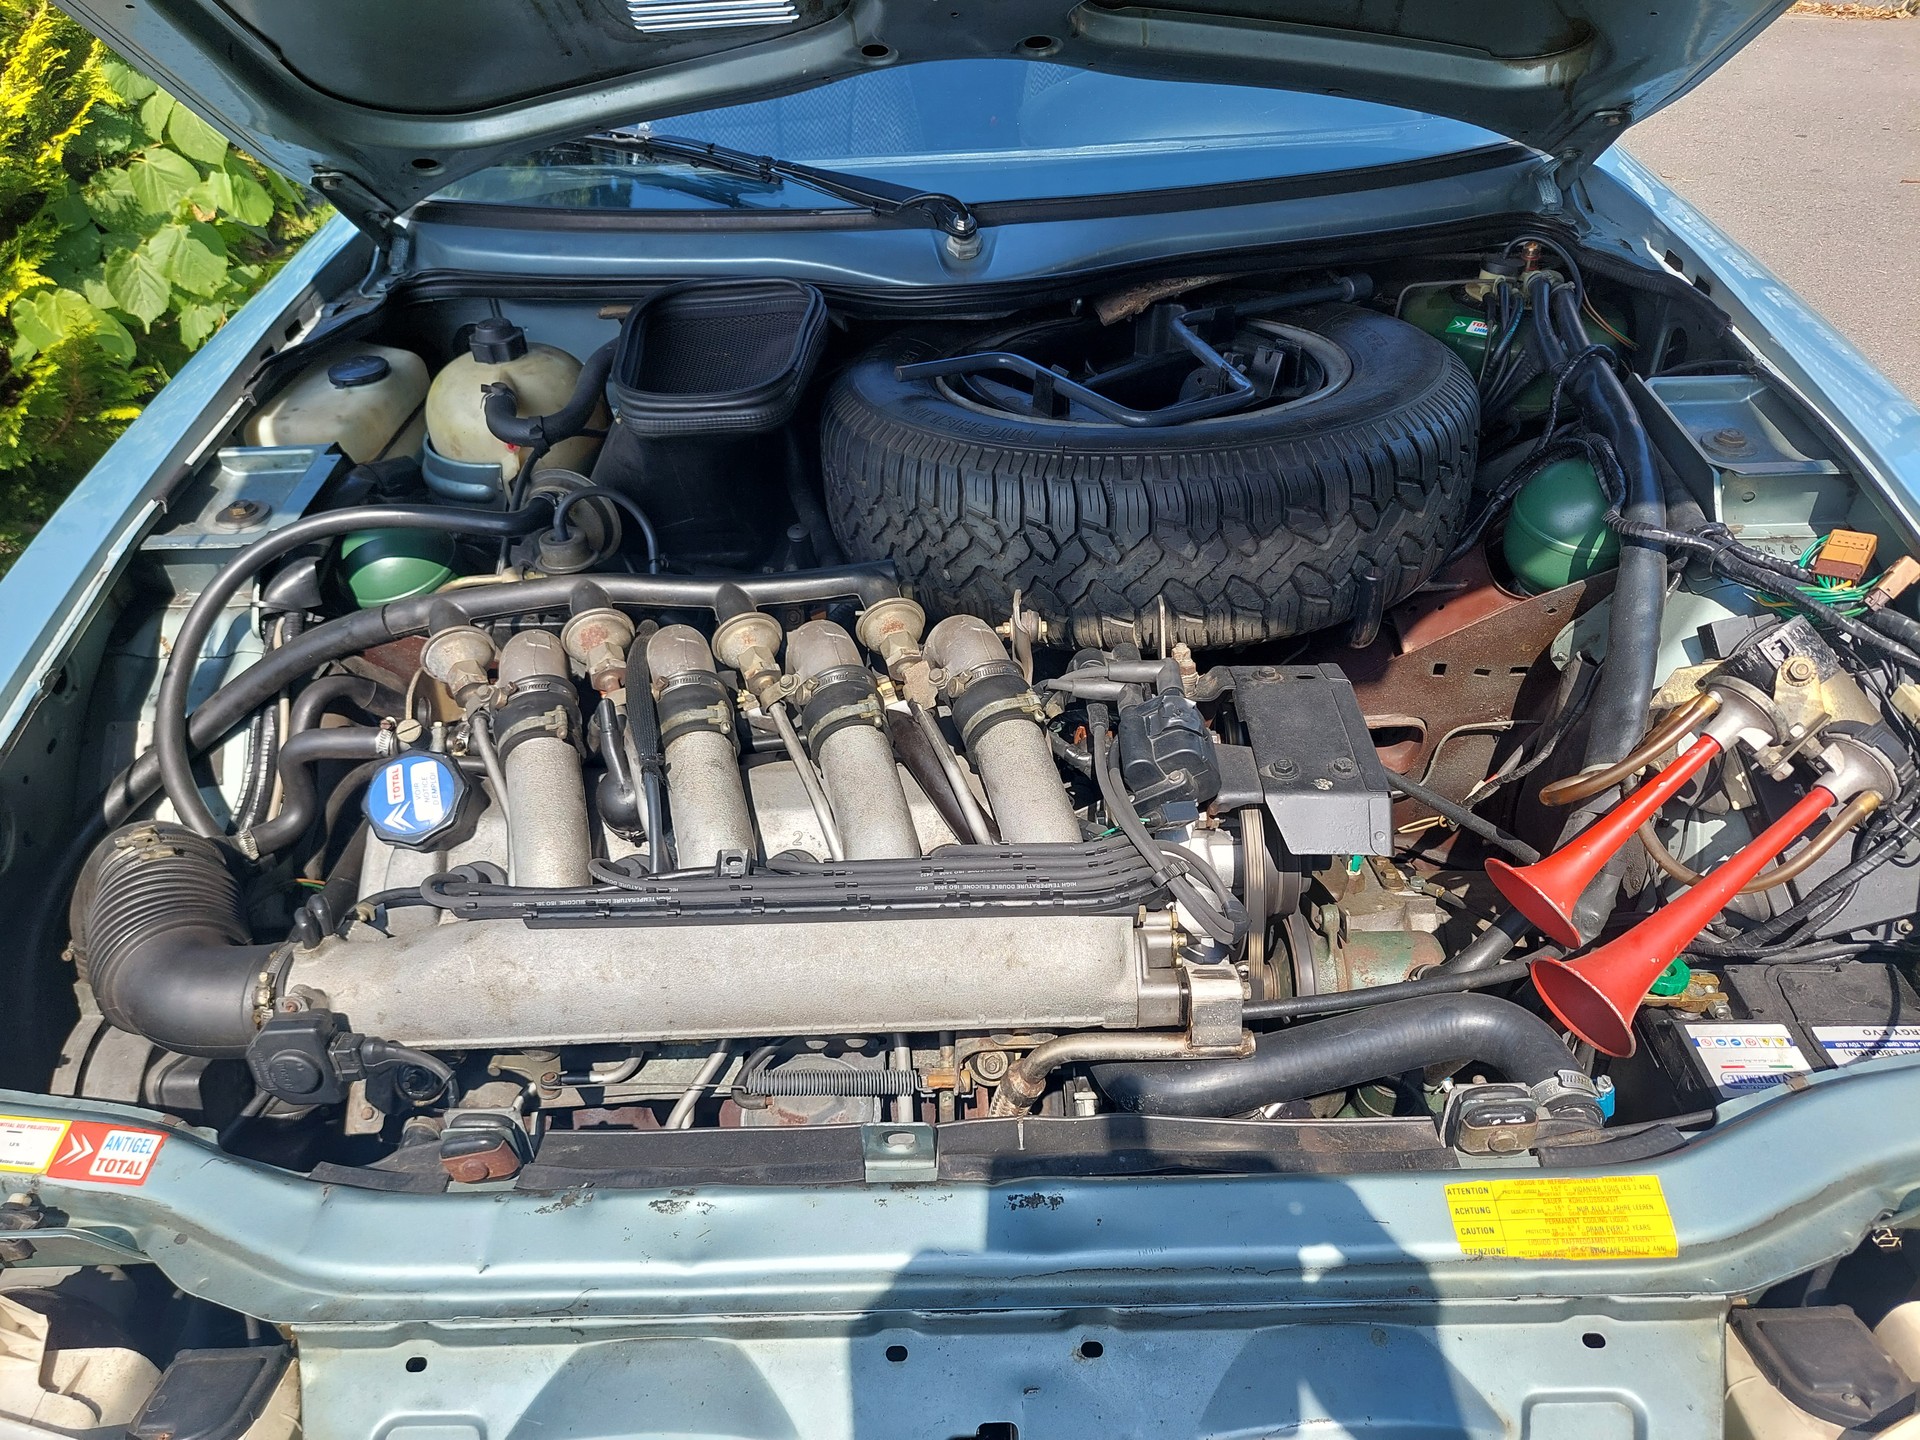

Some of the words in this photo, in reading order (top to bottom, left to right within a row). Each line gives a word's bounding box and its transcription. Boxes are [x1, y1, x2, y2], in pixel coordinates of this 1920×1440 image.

[902, 404, 1038, 443] MICHELIN
[392, 768, 401, 800] TOTAL
[792, 830, 804, 846] 2
[104, 1135, 154, 1154] ANTIGEL
[96, 1158, 142, 1176] TOTAL
[1447, 1187, 1490, 1196] ATTENTION
[1455, 1206, 1491, 1215] ACHTUNG
[1460, 1226, 1495, 1236] CAUTION
